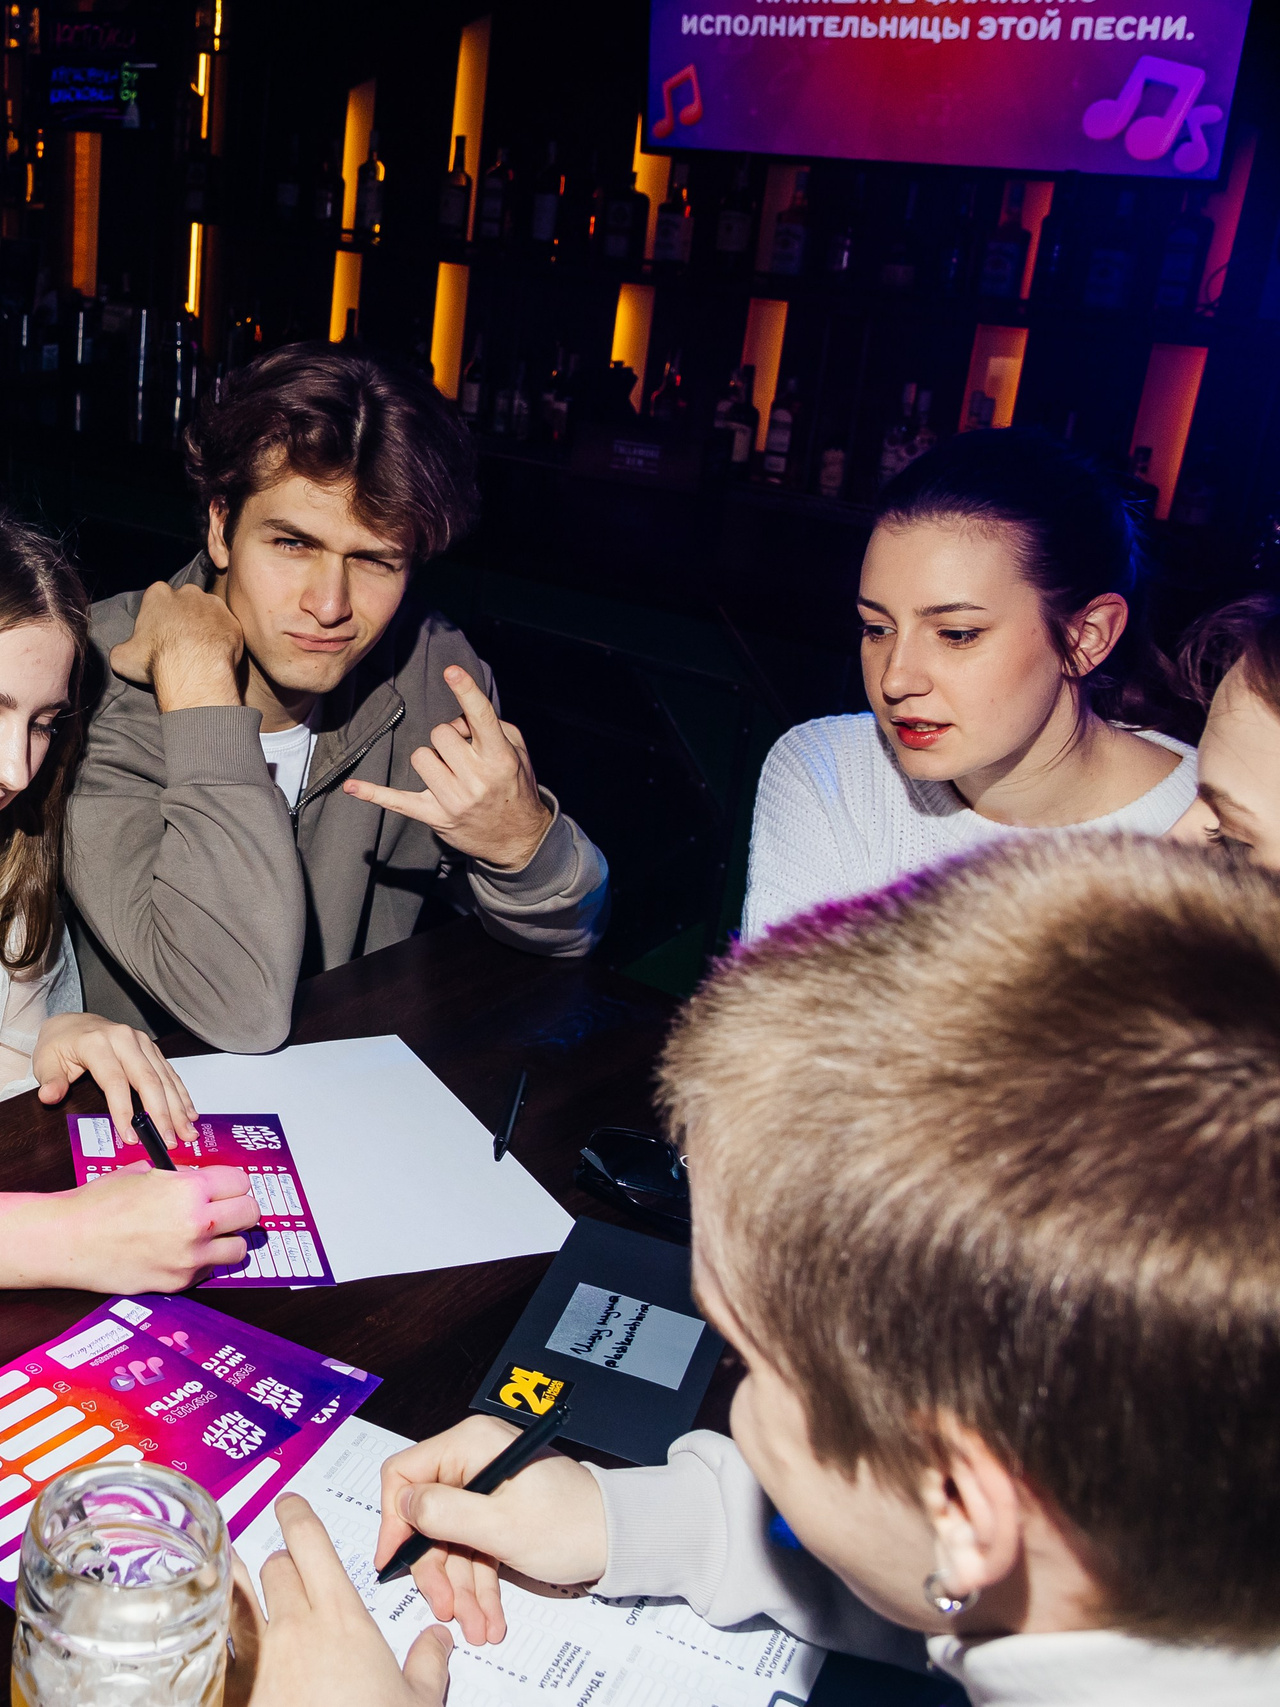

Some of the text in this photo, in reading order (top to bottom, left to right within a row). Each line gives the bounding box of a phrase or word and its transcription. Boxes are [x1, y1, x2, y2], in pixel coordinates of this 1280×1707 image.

[681, 8, 1195, 43] ИСПОЛНИТЕЛЬНИЦЫ ЭТОЙ ПЕСНИ.
[201, 1123, 217, 1148] РАУНД
[231, 1124, 257, 1151] ЛИТИ
[243, 1125, 268, 1150] ЫКА
[255, 1125, 282, 1150] МУЗ
[215, 1345, 236, 1359] НИ
[225, 1352, 246, 1367] НИ
[25, 1363, 43, 1374] 6
[53, 1381, 71, 1393] 5
[144, 1380, 204, 1417] ФИТЫ
[499, 1366, 554, 1415] 24
[81, 1400, 97, 1412] 4
[162, 1390, 217, 1424] РАУНД 2
[281, 1388, 303, 1419] МУ
[110, 1419, 129, 1432] 3
[201, 1410, 244, 1447] ЛИТИ
[212, 1418, 255, 1451] ЫКА
[139, 1438, 158, 1451] 2
[225, 1425, 267, 1459] МУЗ
[171, 1460, 187, 1471] 1
[389, 1594, 416, 1621] РАУНД
[538, 1641, 572, 1689] ИТОГО БАЛЛОВ
[550, 1680, 559, 1689] ЗА
[565, 1645, 583, 1667] РАУНД
[753, 1630, 781, 1677] ИТОГО БАЛЛОВ
[780, 1646, 796, 1675] МАКСИМУМ
[519, 1674, 528, 1683] 10
[566, 1657, 586, 1688] МАКСИМУМ
[764, 1670, 773, 1679] ЗА
[577, 1678, 603, 1707] РАУНД
